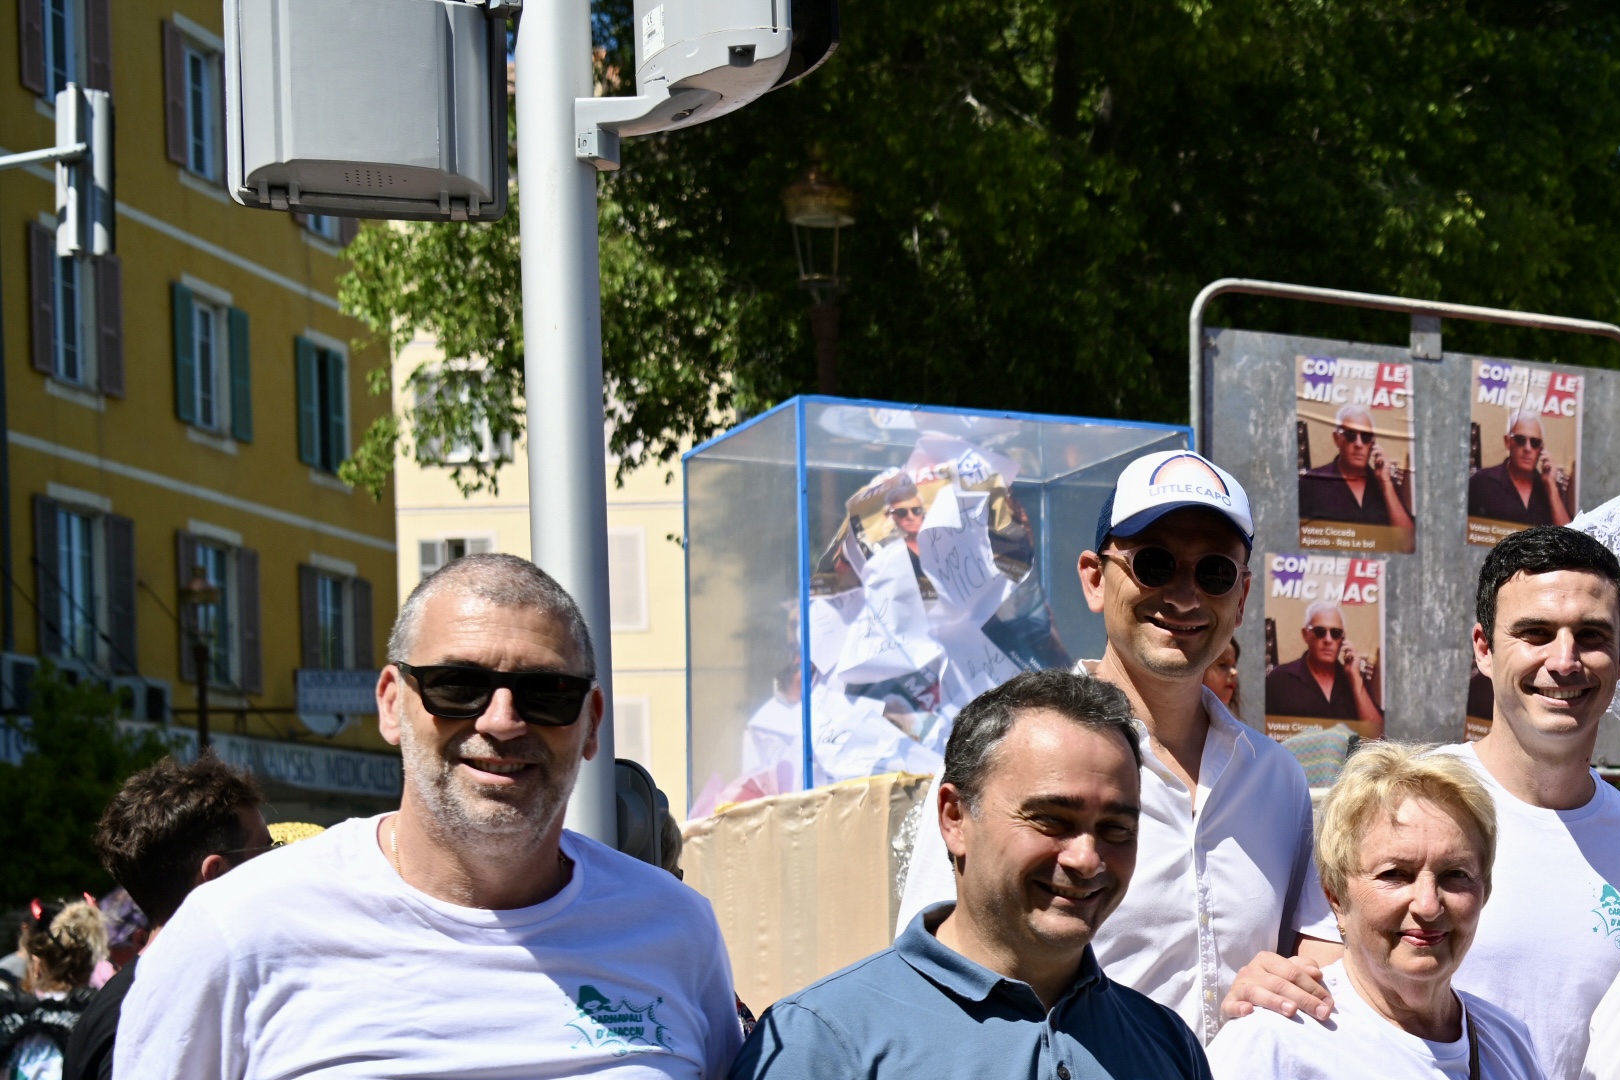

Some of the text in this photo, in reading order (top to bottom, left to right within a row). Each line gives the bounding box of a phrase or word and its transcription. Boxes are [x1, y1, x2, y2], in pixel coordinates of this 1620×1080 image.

[1303, 359, 1405, 382] CONTRE LE
[1303, 381, 1407, 408] MIC MAC
[1555, 375, 1577, 393] LE
[1478, 385, 1576, 417] MIC MAC
[1149, 484, 1232, 507] LITTLE CAPO
[1301, 527, 1356, 538] Votez Ciccada
[1301, 537, 1331, 547] Ajaccio
[1336, 539, 1351, 548] Ras
[1352, 540, 1362, 548] Le
[1363, 540, 1376, 549] bol
[1272, 556, 1378, 578] CONTRE LE
[1272, 579, 1378, 603] MIC MAC
[1267, 722, 1290, 732] Votez
[590, 1013, 643, 1025] CARNAVALI
